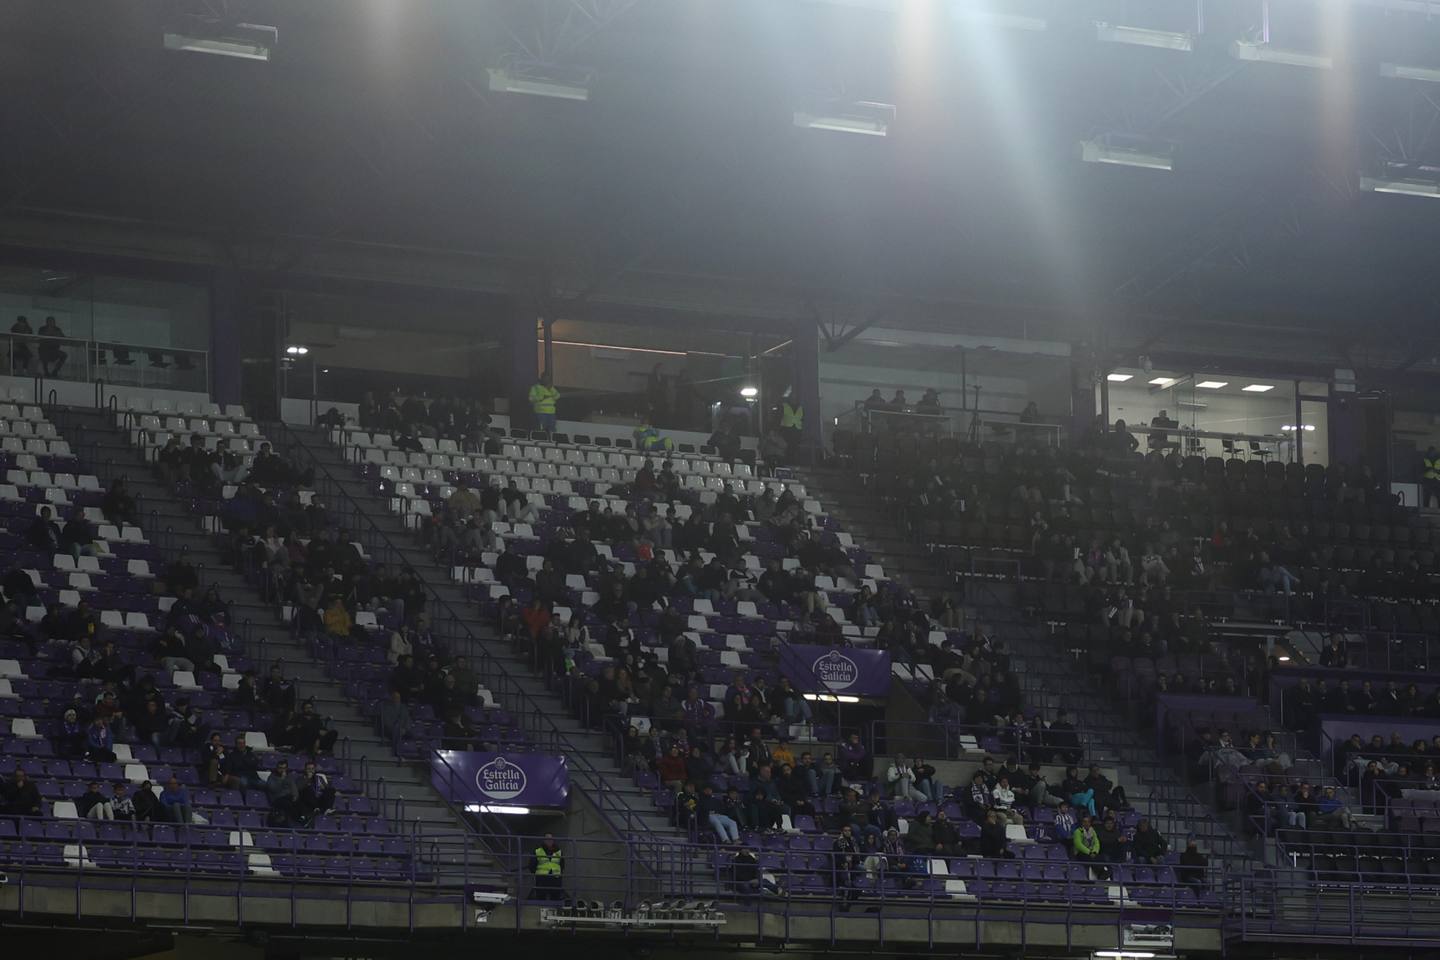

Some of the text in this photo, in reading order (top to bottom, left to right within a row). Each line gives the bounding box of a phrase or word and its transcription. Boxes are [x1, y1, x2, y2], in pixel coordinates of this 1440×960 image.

[818, 660, 852, 671] Estrella
[820, 670, 851, 681] Galicia
[483, 769, 520, 780] Estrella
[485, 779, 519, 790] Galicia
